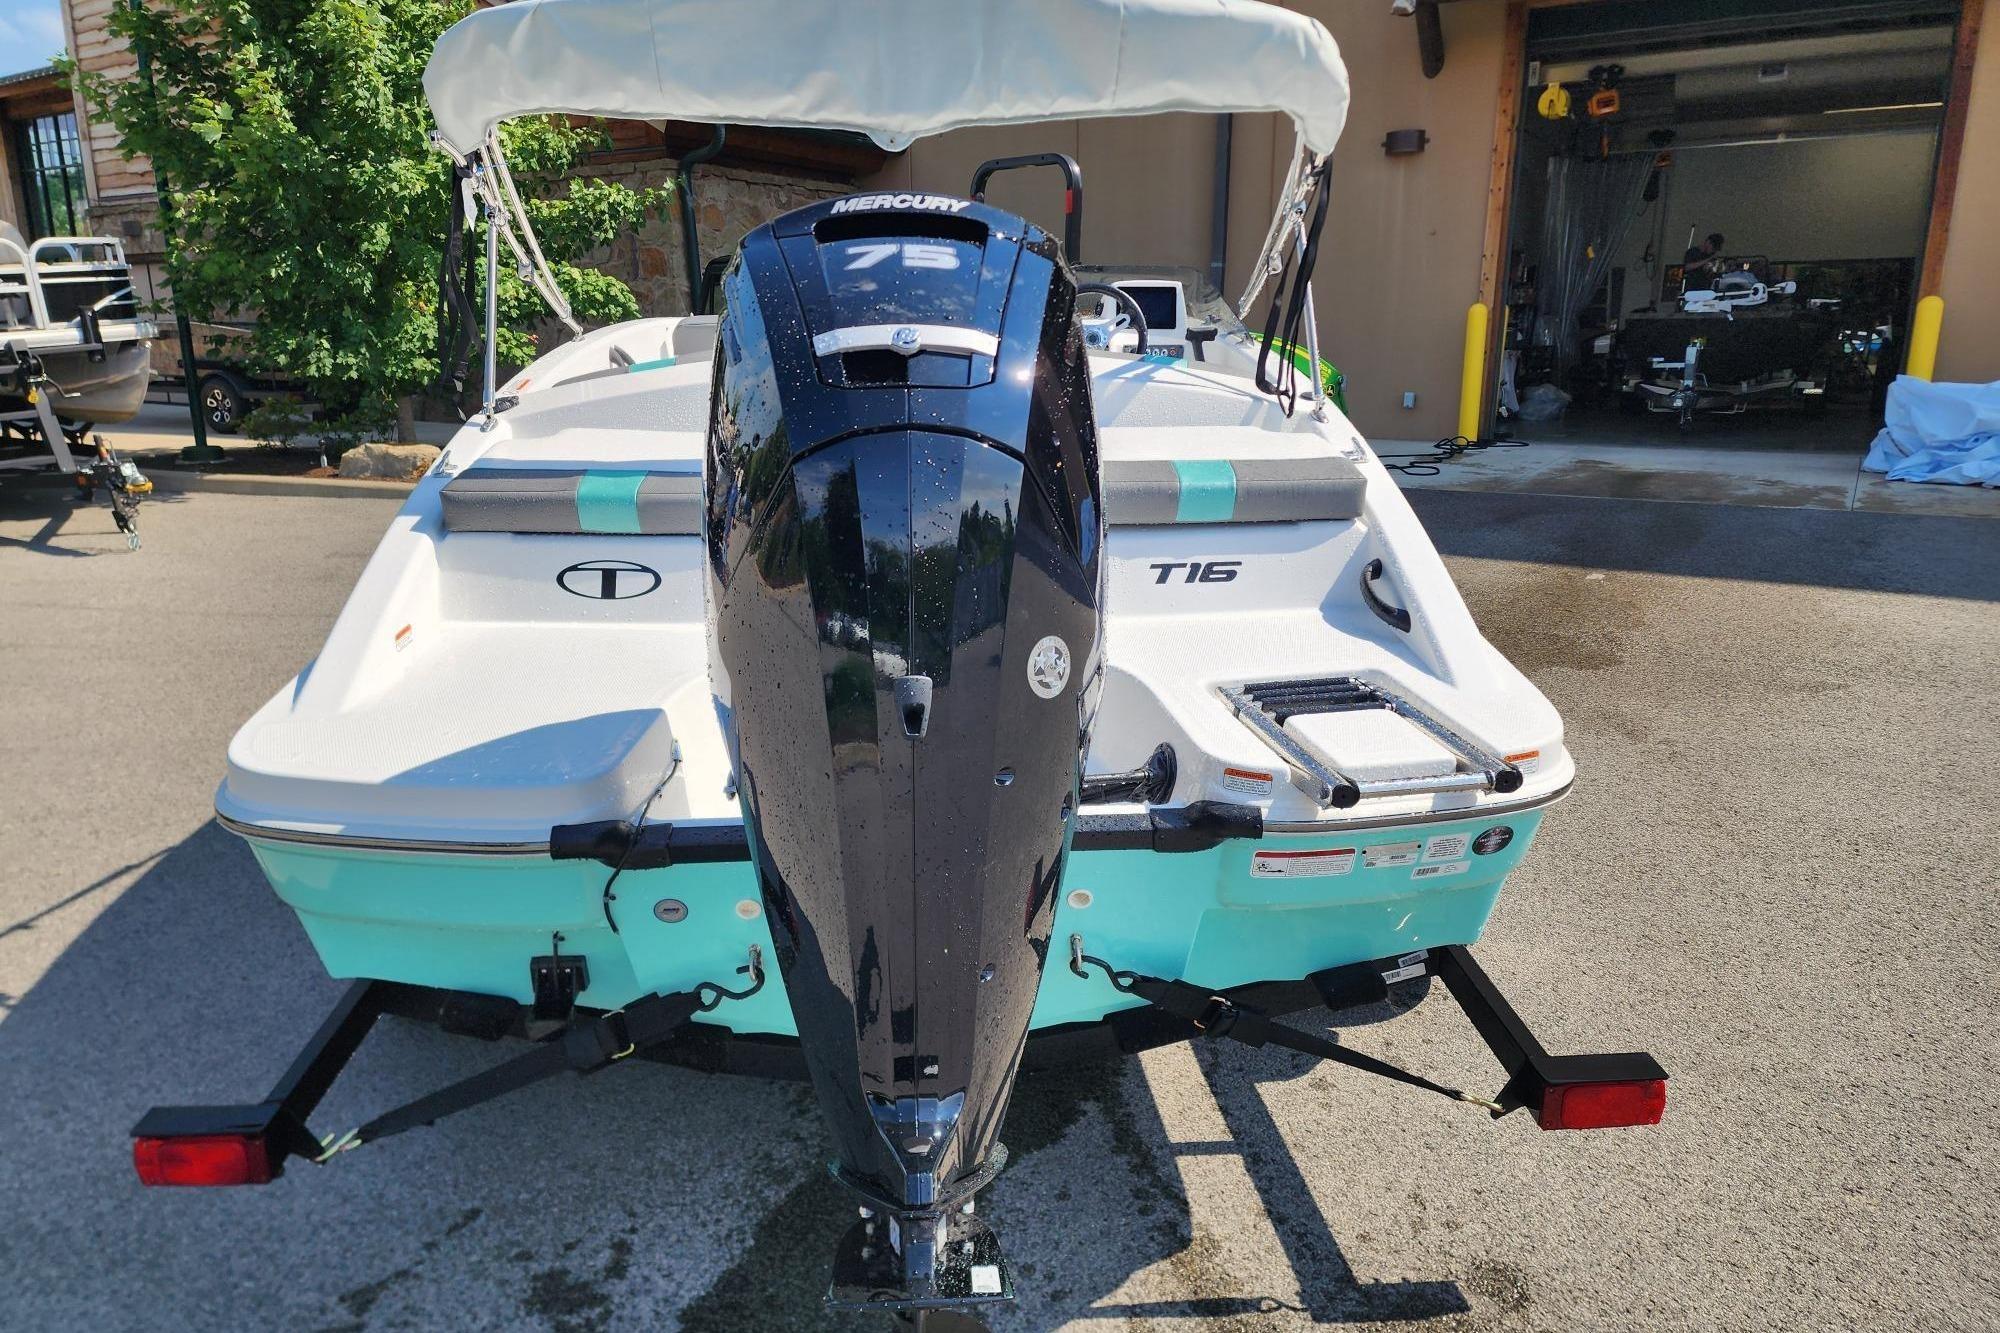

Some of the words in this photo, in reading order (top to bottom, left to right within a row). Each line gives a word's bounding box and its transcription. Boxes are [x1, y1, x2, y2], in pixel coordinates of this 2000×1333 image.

[830, 194, 970, 214] MERCURY
[844, 243, 960, 271] 75
[1149, 561, 1242, 585] T16
